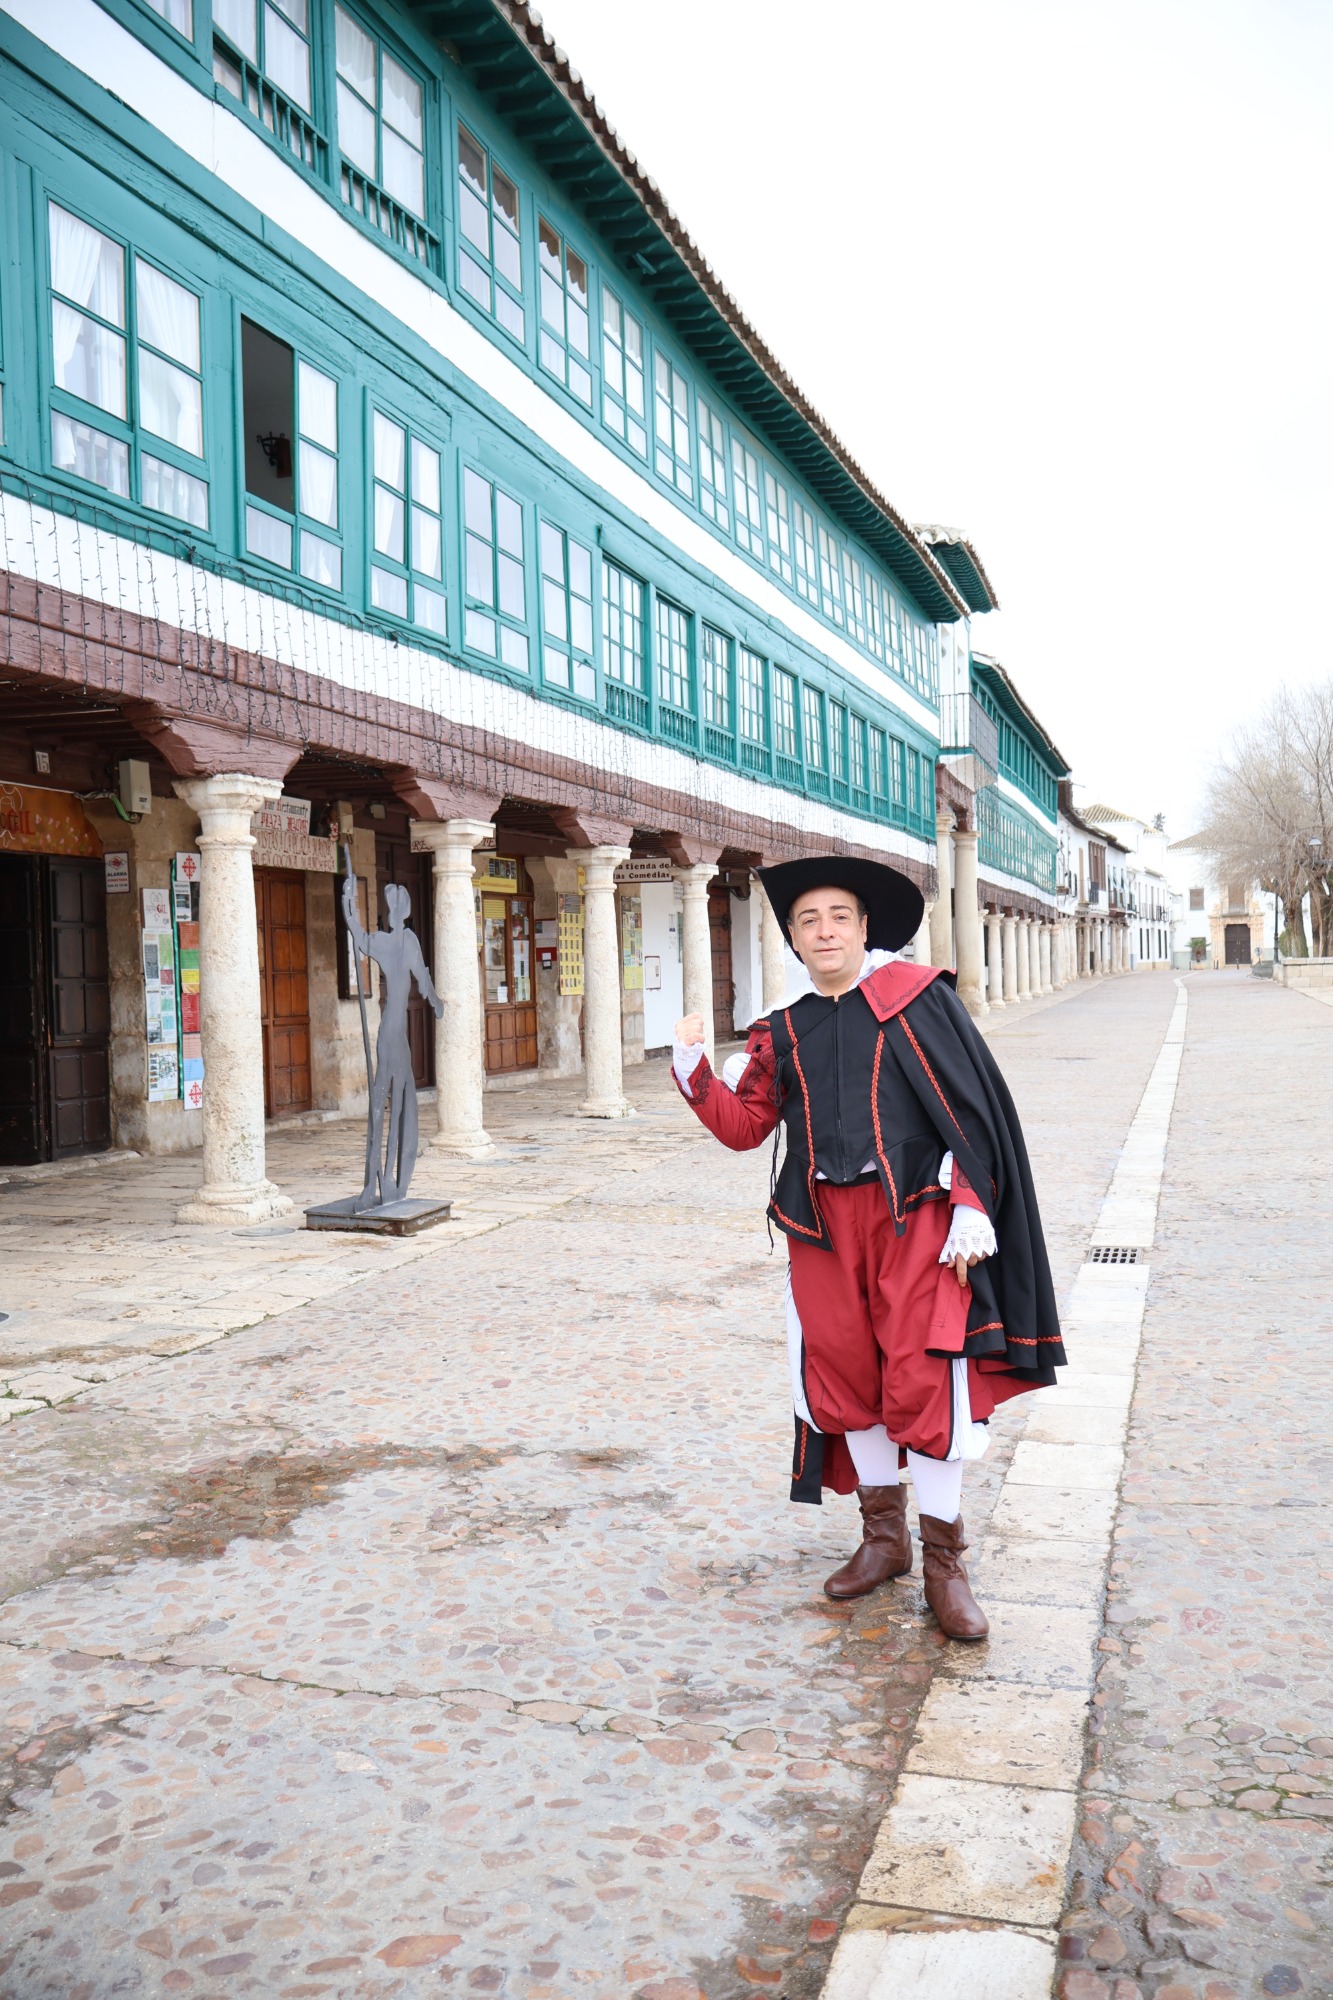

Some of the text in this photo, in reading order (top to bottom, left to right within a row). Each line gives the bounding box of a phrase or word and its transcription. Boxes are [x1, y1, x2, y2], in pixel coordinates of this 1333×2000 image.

[38, 753, 49, 773] 15
[261, 812, 282, 831] PLAZA
[626, 862, 657, 871] tienda
[629, 871, 670, 880] Comedias
